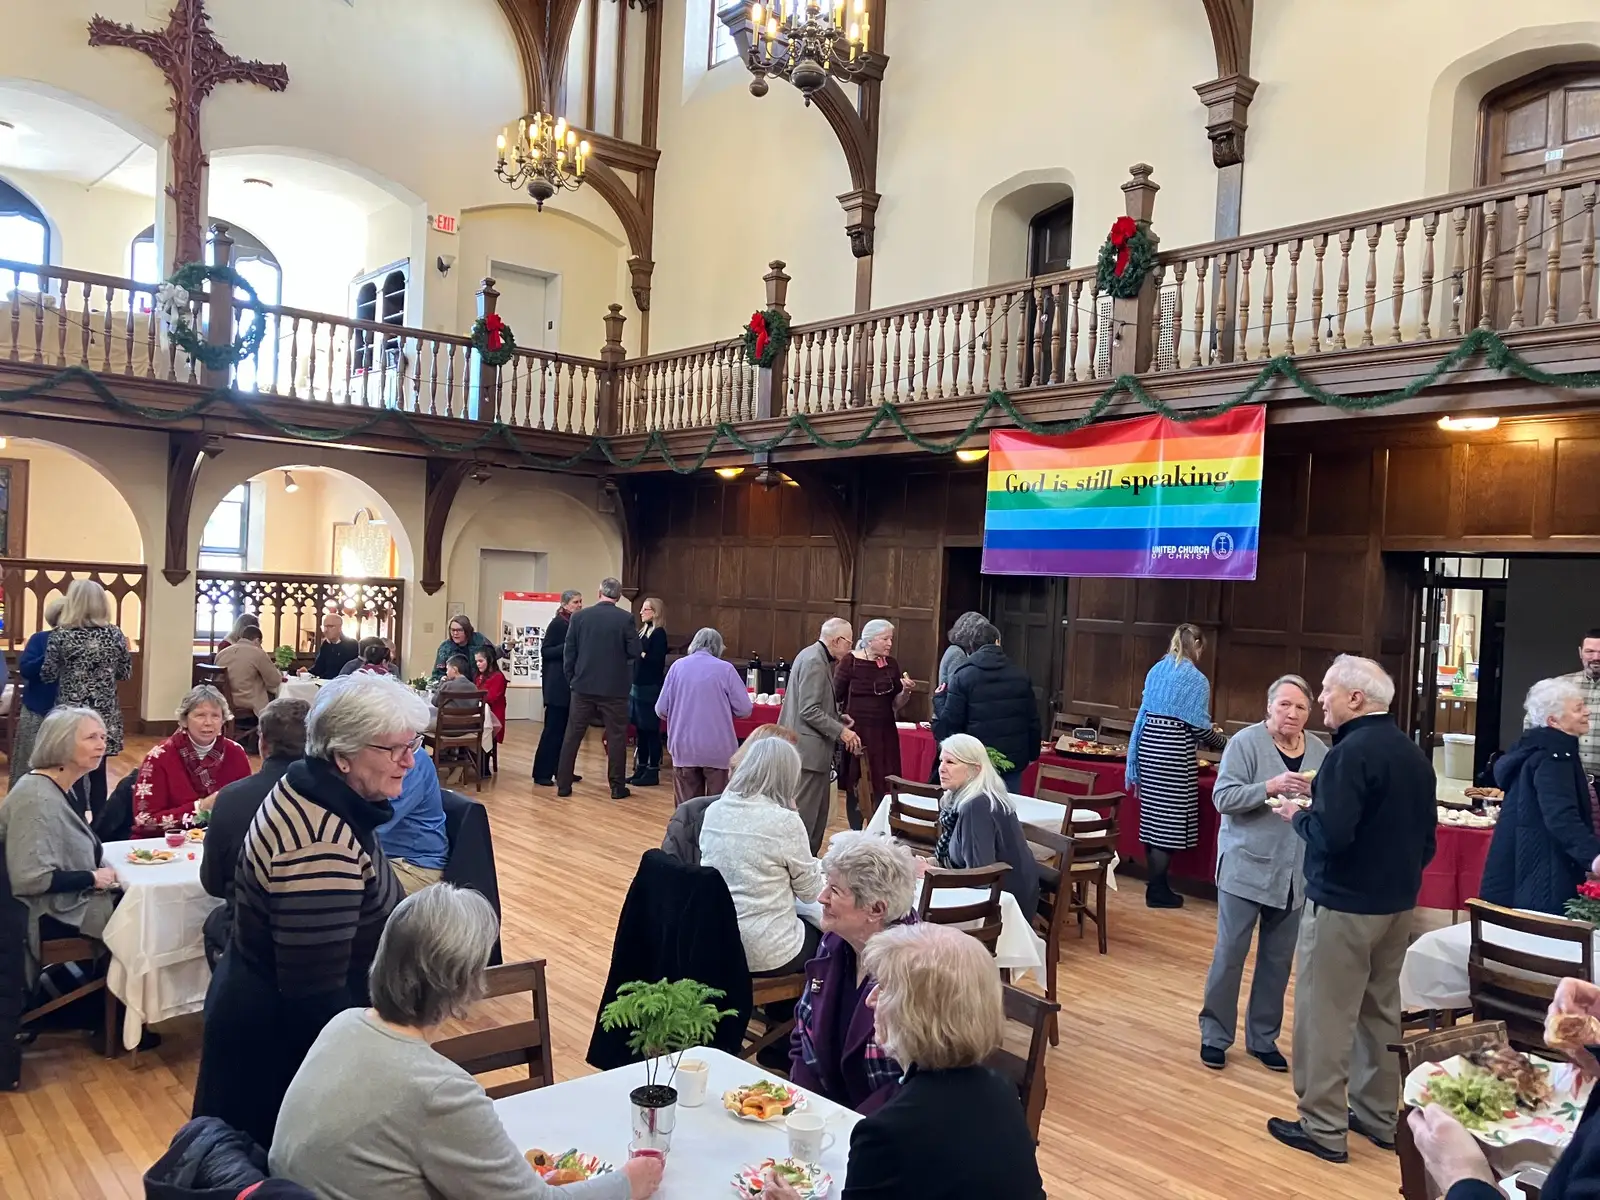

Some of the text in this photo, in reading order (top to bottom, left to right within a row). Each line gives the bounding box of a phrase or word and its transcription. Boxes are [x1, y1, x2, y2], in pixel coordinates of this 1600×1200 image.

[437, 214, 455, 231] EXIT
[1005, 464, 1235, 496] God is still speaking,
[1151, 545, 1210, 554] UNITED CHURCH
